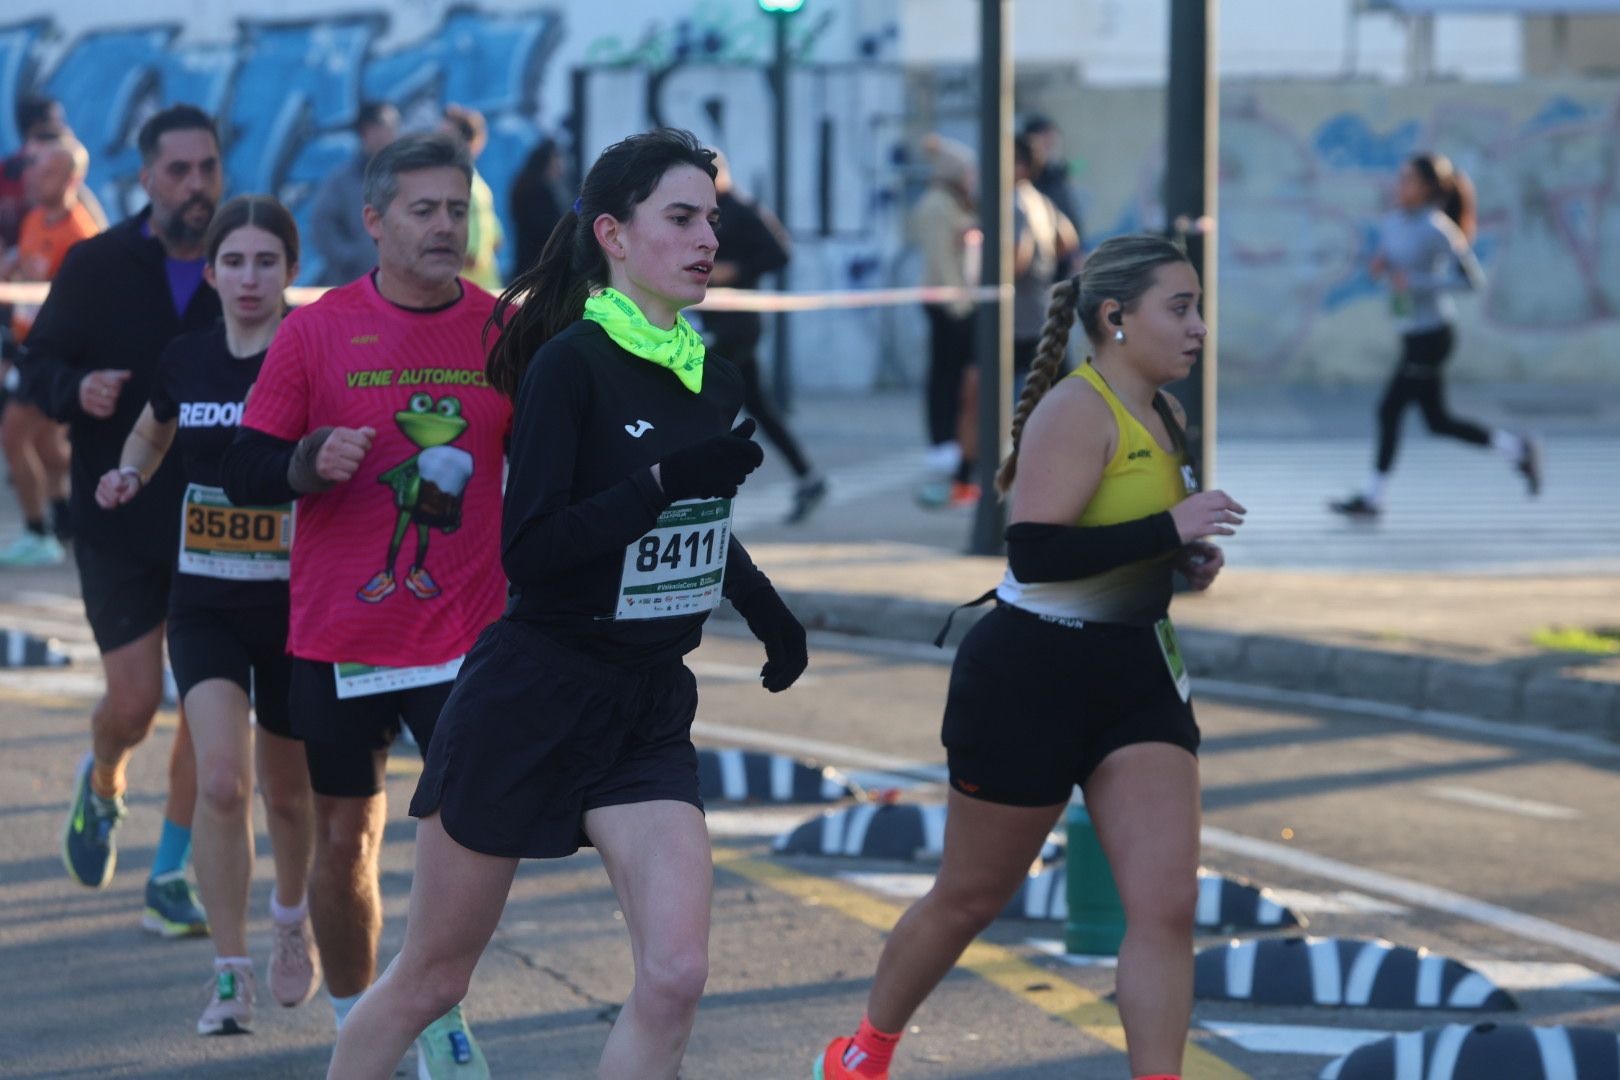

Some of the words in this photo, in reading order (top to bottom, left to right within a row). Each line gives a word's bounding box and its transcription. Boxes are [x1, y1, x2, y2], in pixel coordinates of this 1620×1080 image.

[346, 369, 394, 387] VENE
[188, 507, 276, 542] 3580
[636, 528, 716, 573] 8411
